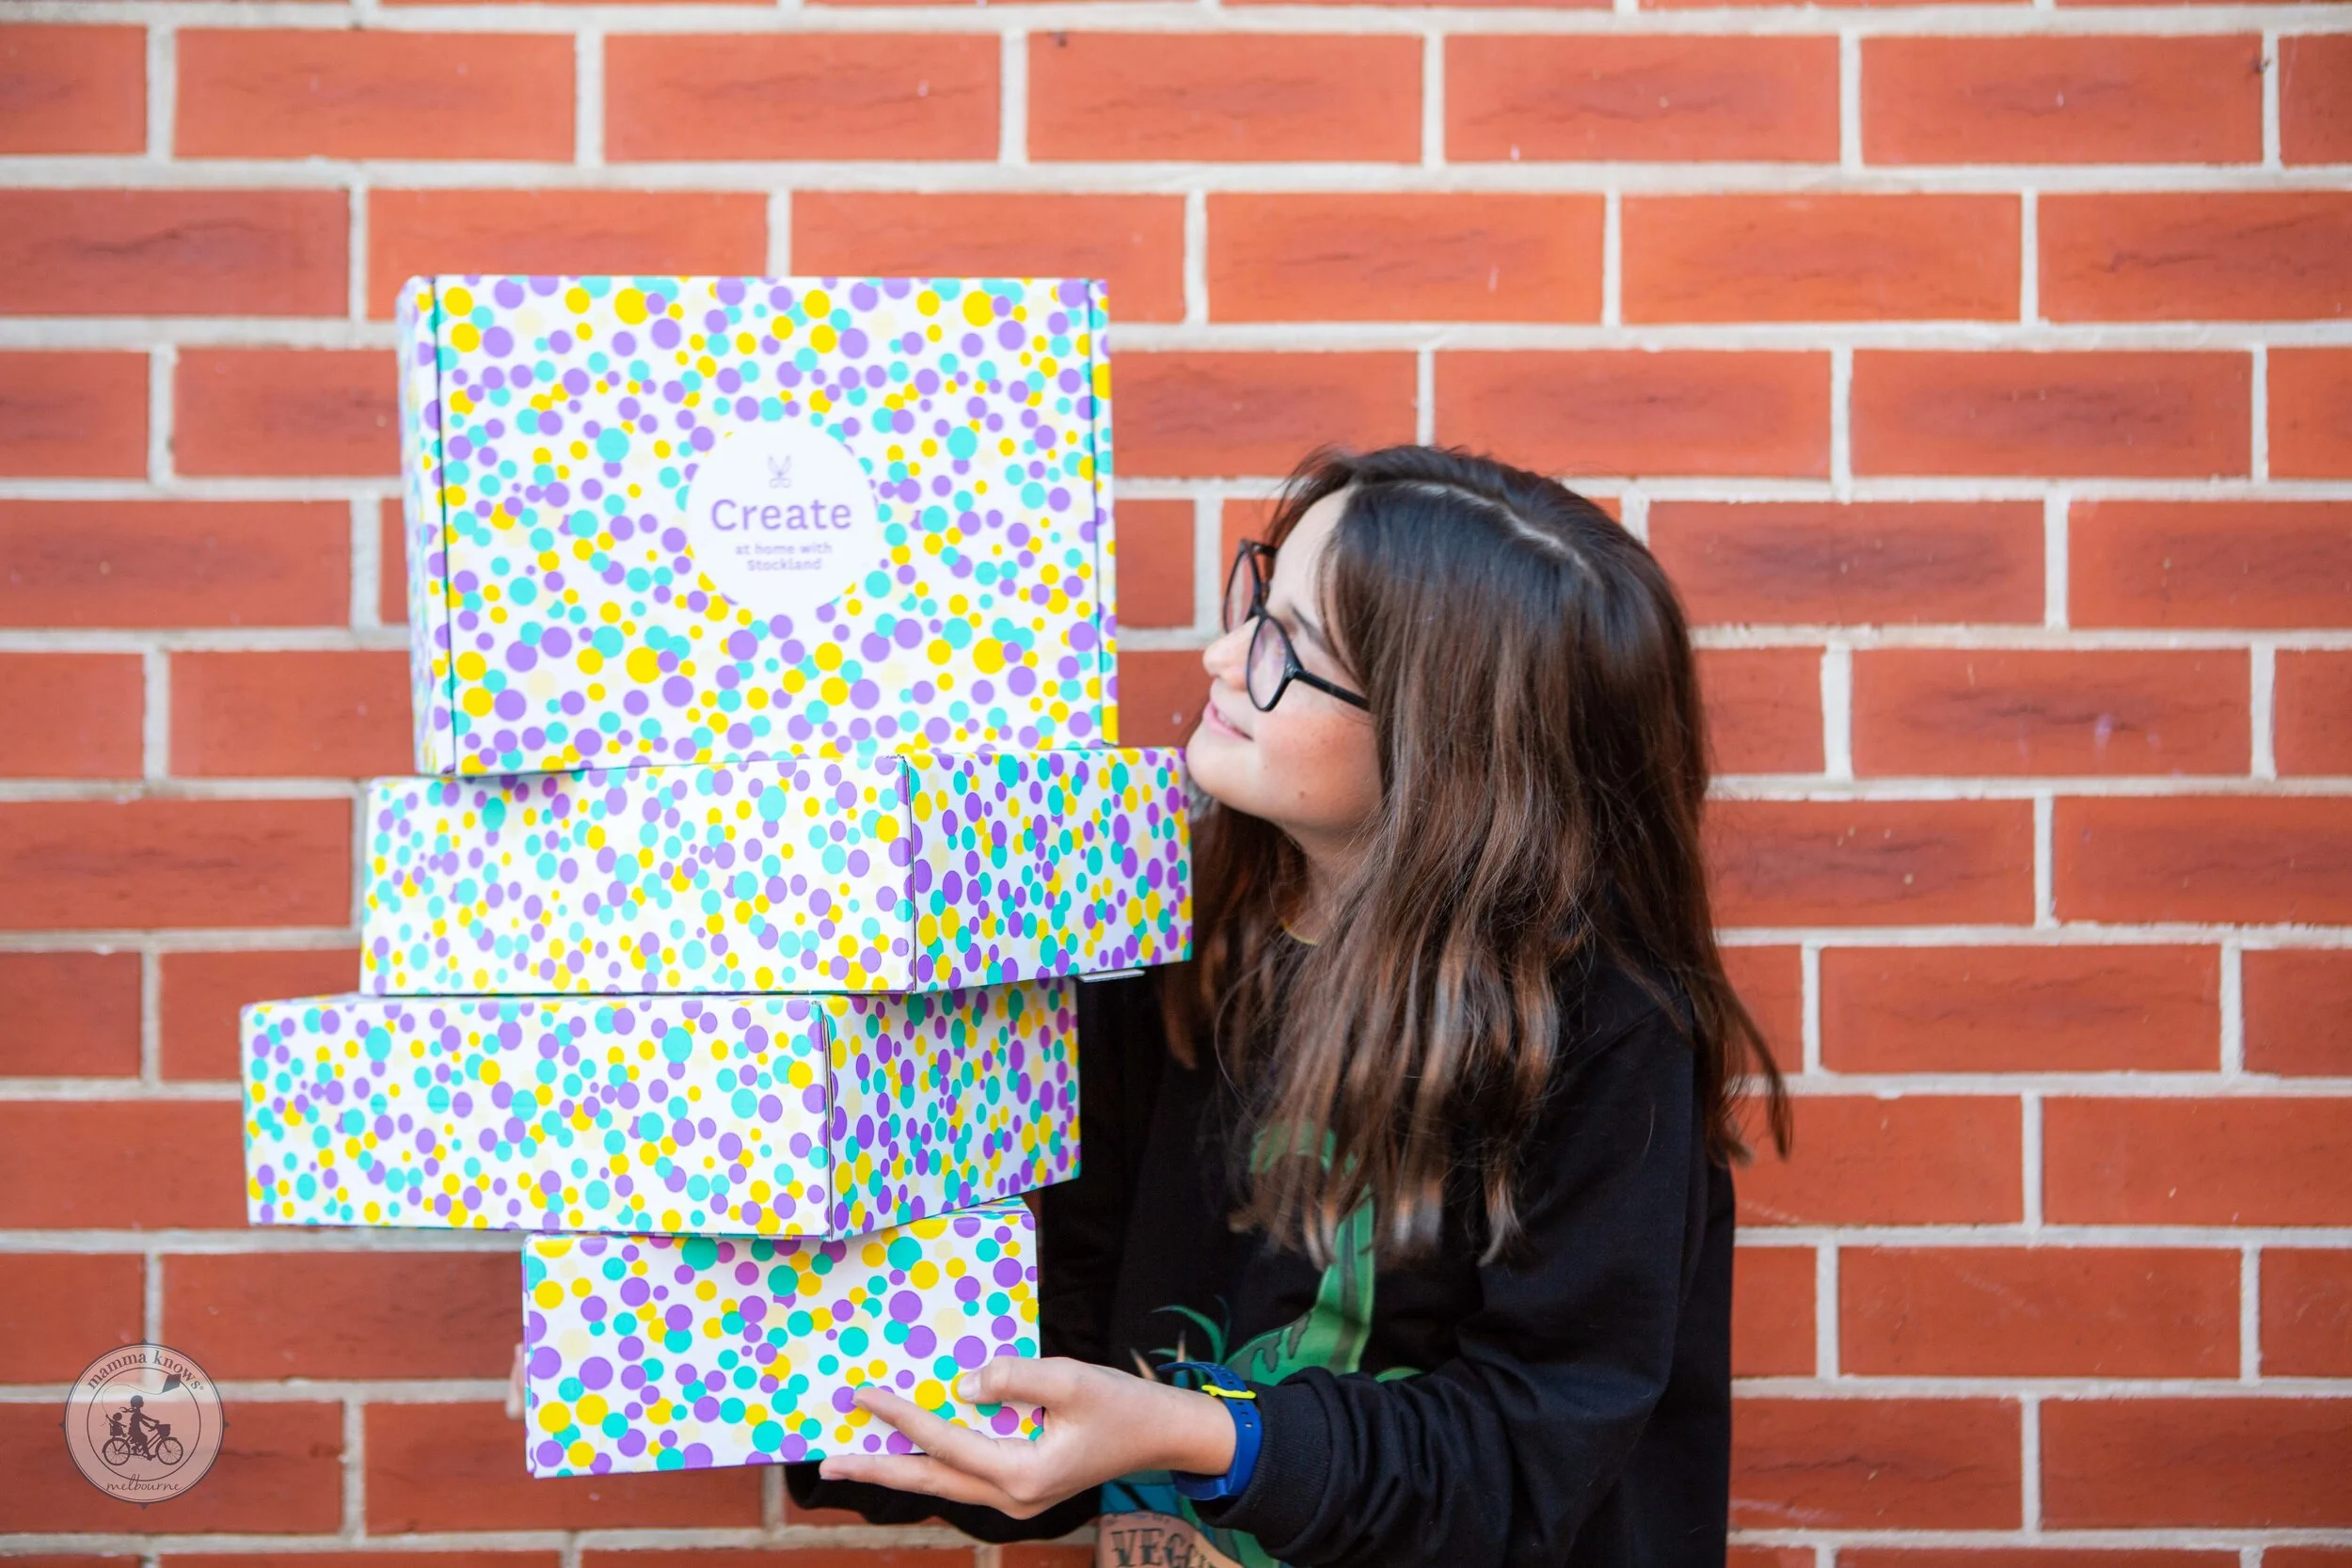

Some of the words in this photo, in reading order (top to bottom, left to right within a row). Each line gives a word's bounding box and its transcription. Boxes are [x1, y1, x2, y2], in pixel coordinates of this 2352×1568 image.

[710, 499, 851, 531] Create
[735, 543, 750, 555] at
[754, 542, 795, 555] home
[799, 541, 833, 555] with
[746, 558, 822, 572] Stockland
